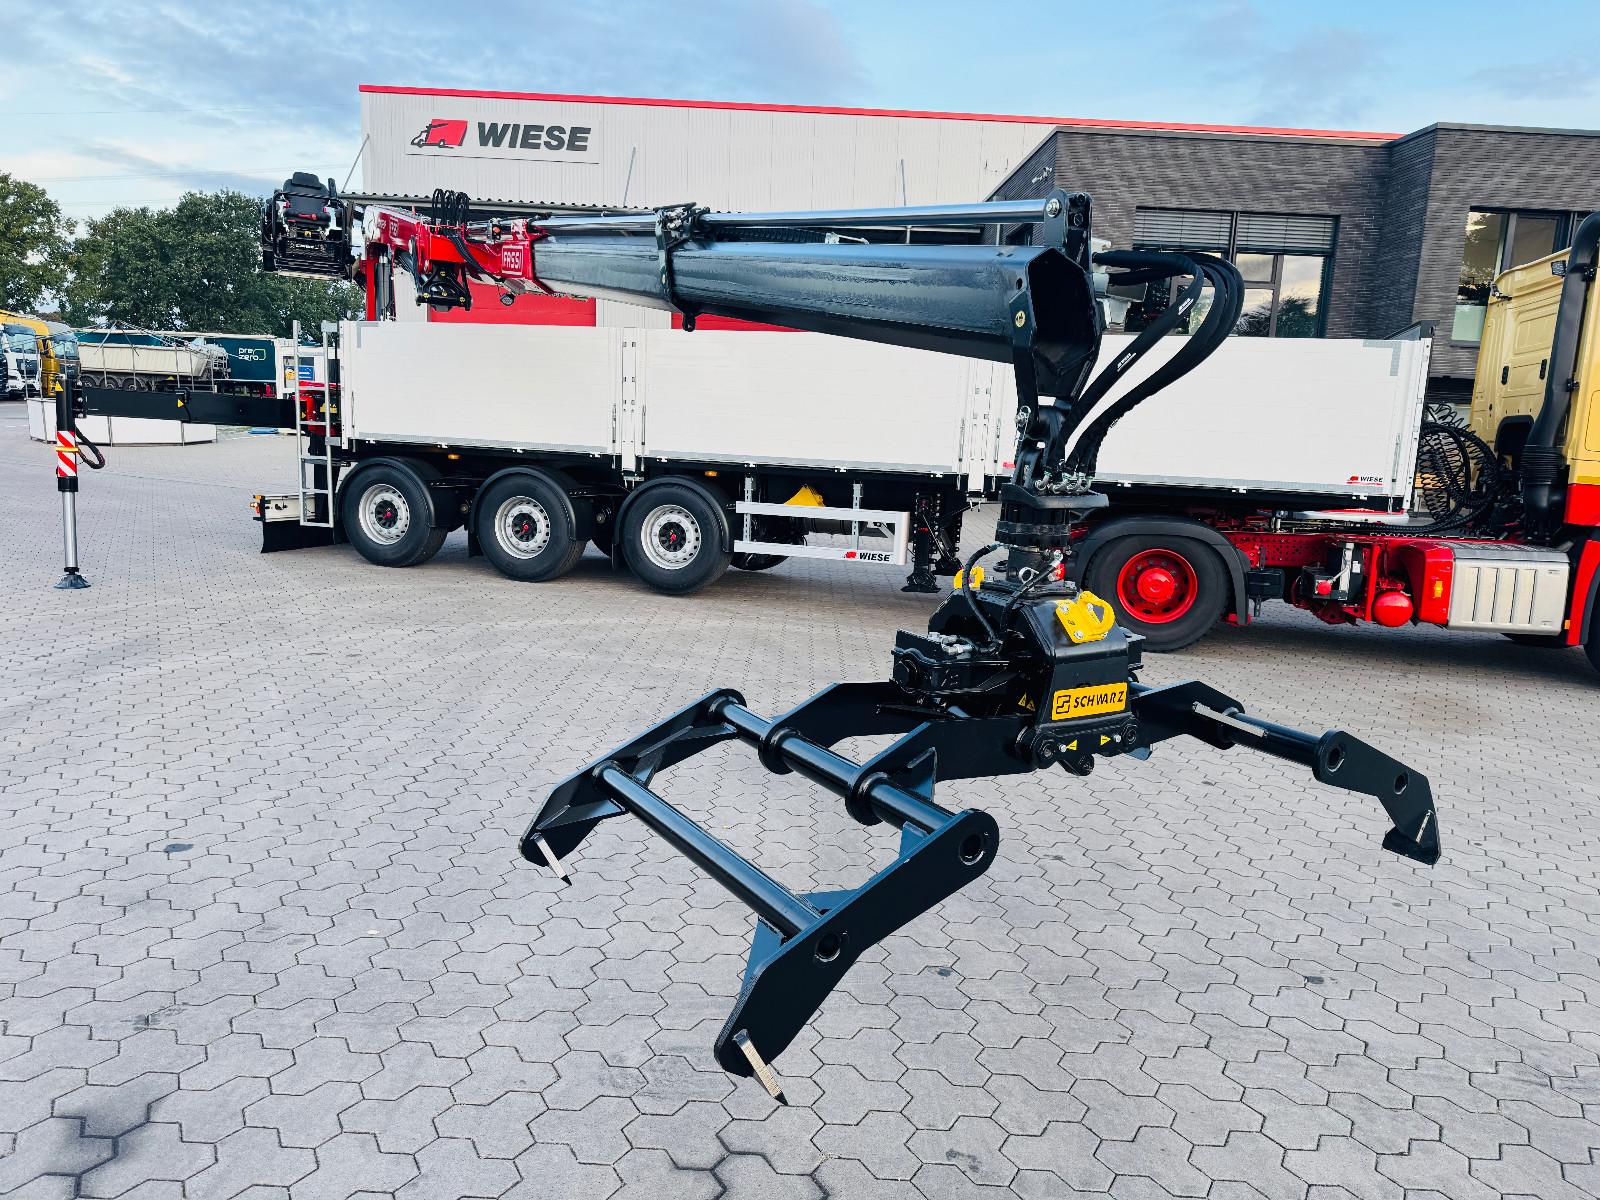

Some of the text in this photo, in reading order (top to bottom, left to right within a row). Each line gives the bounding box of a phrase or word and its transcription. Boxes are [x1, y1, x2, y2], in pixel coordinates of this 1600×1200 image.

[477, 121, 592, 151] WIESE
[503, 251, 522, 268] FASSI
[859, 552, 891, 562] WIESE
[1073, 690, 1125, 708] SCHWARZ
